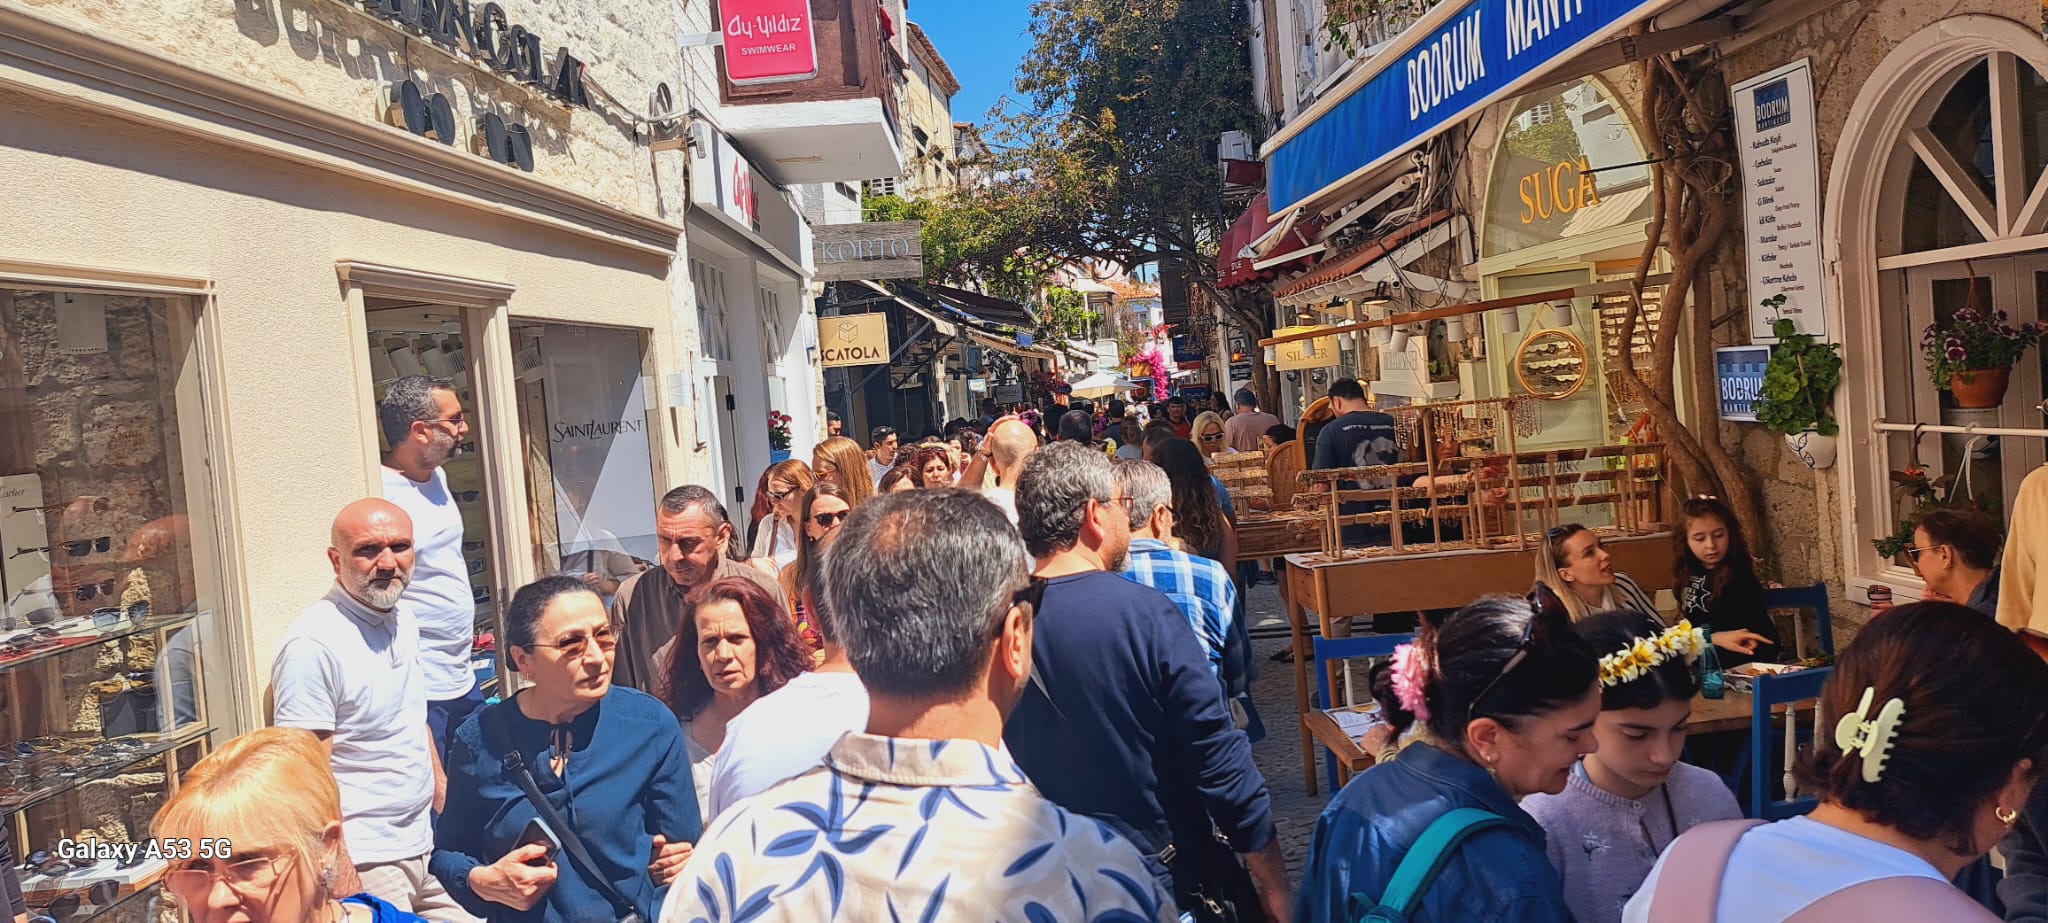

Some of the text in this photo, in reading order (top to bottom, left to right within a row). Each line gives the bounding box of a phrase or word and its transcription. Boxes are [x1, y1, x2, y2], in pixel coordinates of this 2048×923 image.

[741, 43, 796, 56] SWIMWEAR
[1407, 0, 1583, 121] BODRUM MAN
[1756, 96, 1789, 121] BODRUM
[1519, 154, 1601, 224] SUGA
[821, 237, 910, 264] KORTO
[820, 346, 880, 361] SCATOLA
[1286, 347, 1328, 361] SILER
